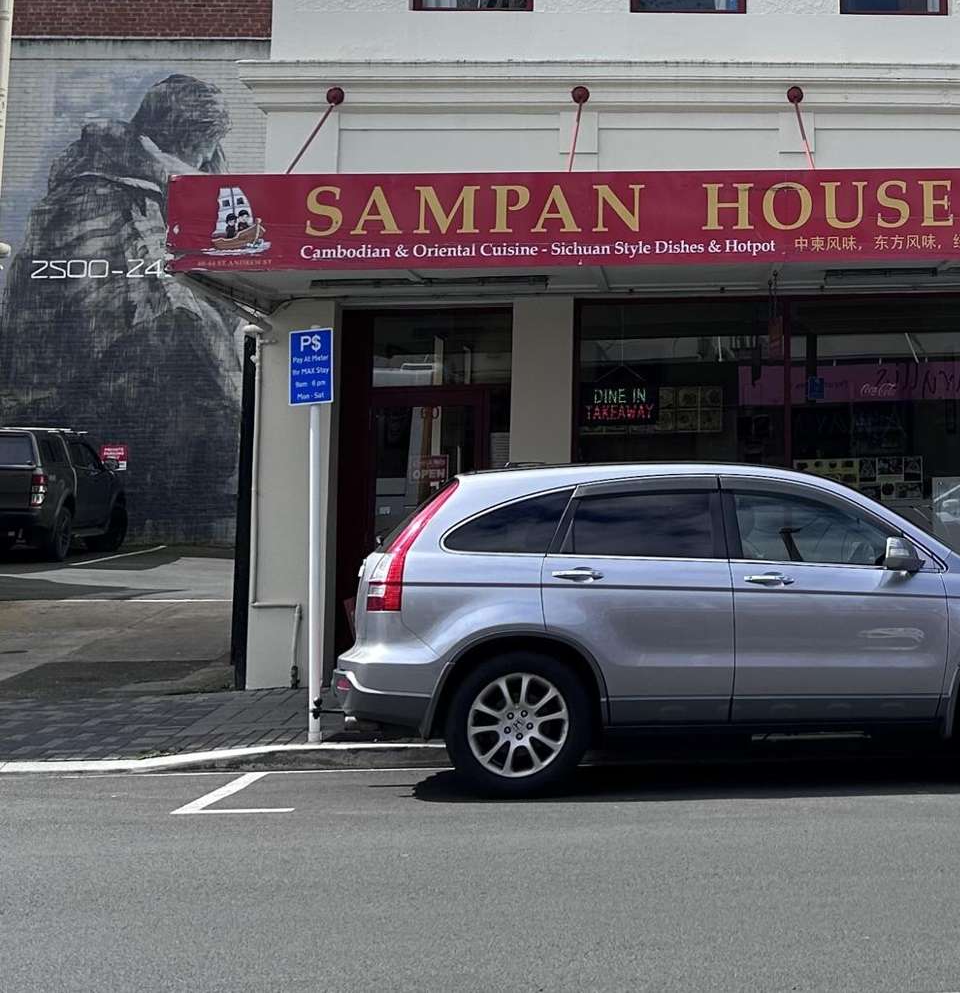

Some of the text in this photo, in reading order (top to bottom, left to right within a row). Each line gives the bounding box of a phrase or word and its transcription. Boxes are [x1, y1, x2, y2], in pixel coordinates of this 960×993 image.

[304, 180, 954, 238] SAMPAN HOUSE
[300, 245, 390, 259] Cambodian
[395, 245, 409, 258] &
[413, 243, 475, 257] Oriental
[480, 243, 538, 257] Cuisine
[551, 242, 610, 256] Sichuan
[614, 241, 651, 258] Style
[655, 240, 704, 254] Dishes
[708, 240, 721, 253] &
[725, 239, 776, 256] Hotpot
[31, 259, 171, 279] 2500-24
[300, 334, 322, 352] P$
[594, 387, 646, 404] DINE IN
[586, 404, 654, 420] TAKEAWAY
[412, 469, 446, 479] OPEN
